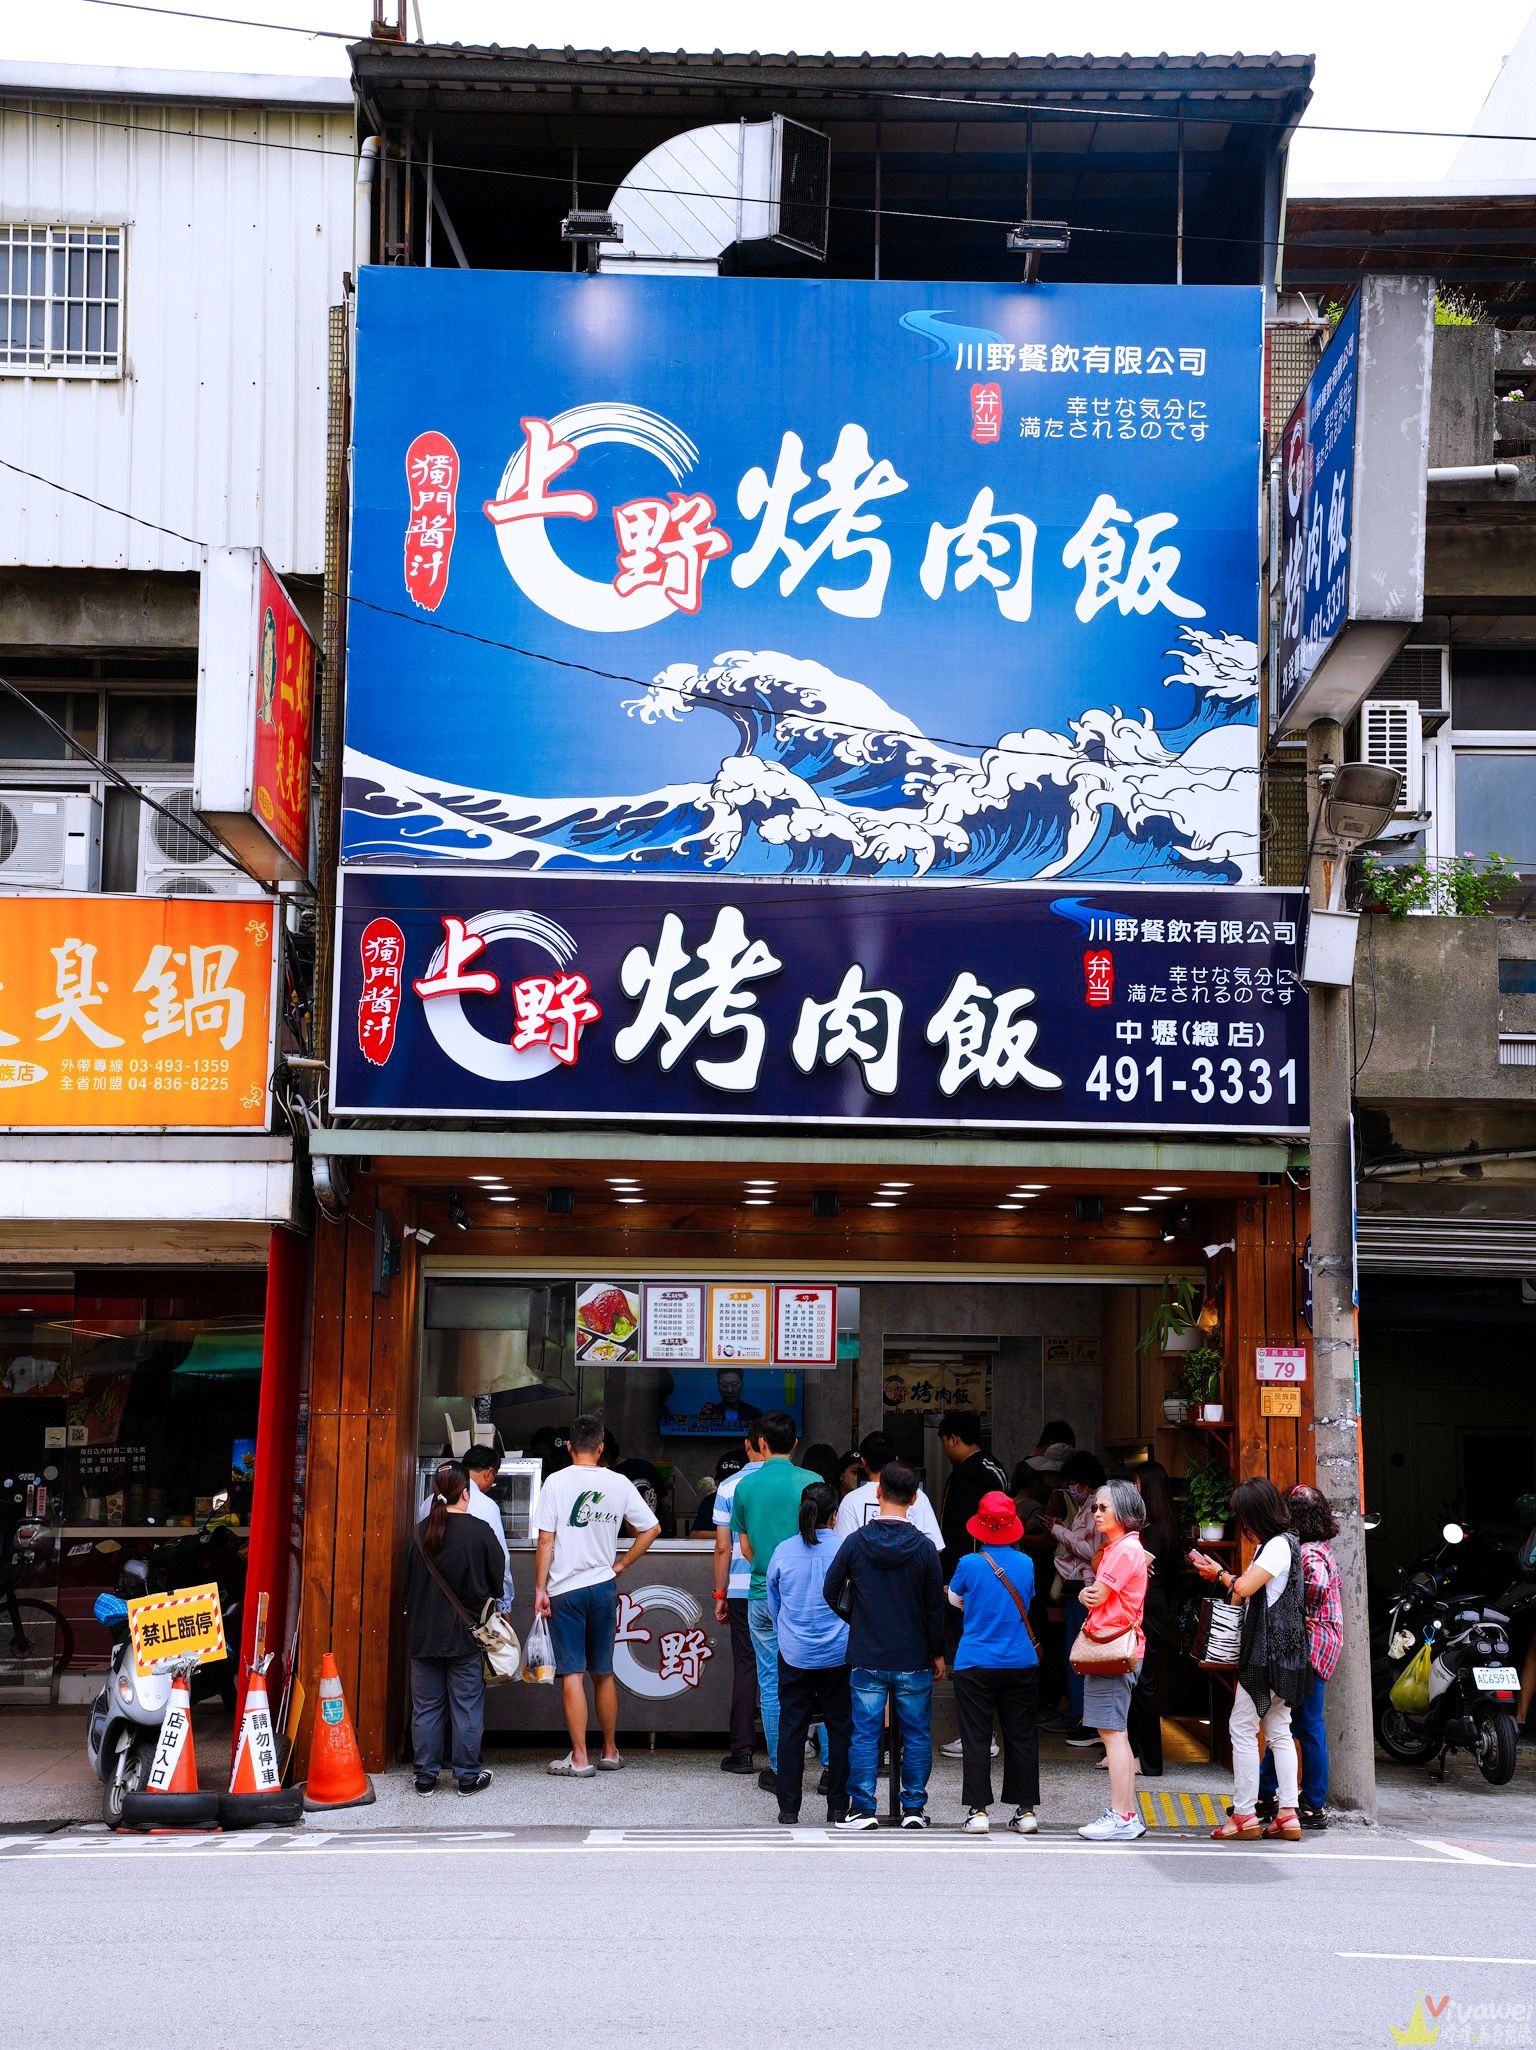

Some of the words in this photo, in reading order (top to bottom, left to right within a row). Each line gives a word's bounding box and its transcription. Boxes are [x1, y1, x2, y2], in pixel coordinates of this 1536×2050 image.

[955, 342, 1207, 376] 川野餐飲有限公司
[974, 389, 1000, 438] 弁当
[1066, 396, 1208, 420] 幸せな気分に
[1018, 416, 1209, 442] 満たされるのです
[406, 453, 454, 588] 獨門醬汁
[1088, 918, 1297, 946] 川野餐飲有限公司
[359, 936, 401, 1047] 獨門醬汁
[1087, 956, 1111, 1003] 弁当
[1168, 965, 1295, 986] 幸せな気分に
[0, 938, 246, 1051] 臭鍋
[1127, 984, 1296, 1006] 満たされるのです
[60, 1075, 123, 1090] 全省加盟
[128, 1076, 229, 1090] 04-836-8225
[61, 1058, 123, 1073] 外帶專線
[129, 1059, 229, 1073] 03-493-1359
[1086, 1055, 1297, 1105] 491-3331
[1274, 1361, 1295, 1378] 79
[1278, 1403, 1293, 1414] 79
[141, 1611, 214, 1648] 禁止臨停
[614, 1592, 714, 1688] 上野
[151, 1711, 186, 1786] 店出入口
[251, 1713, 277, 1785] 請勿停車
